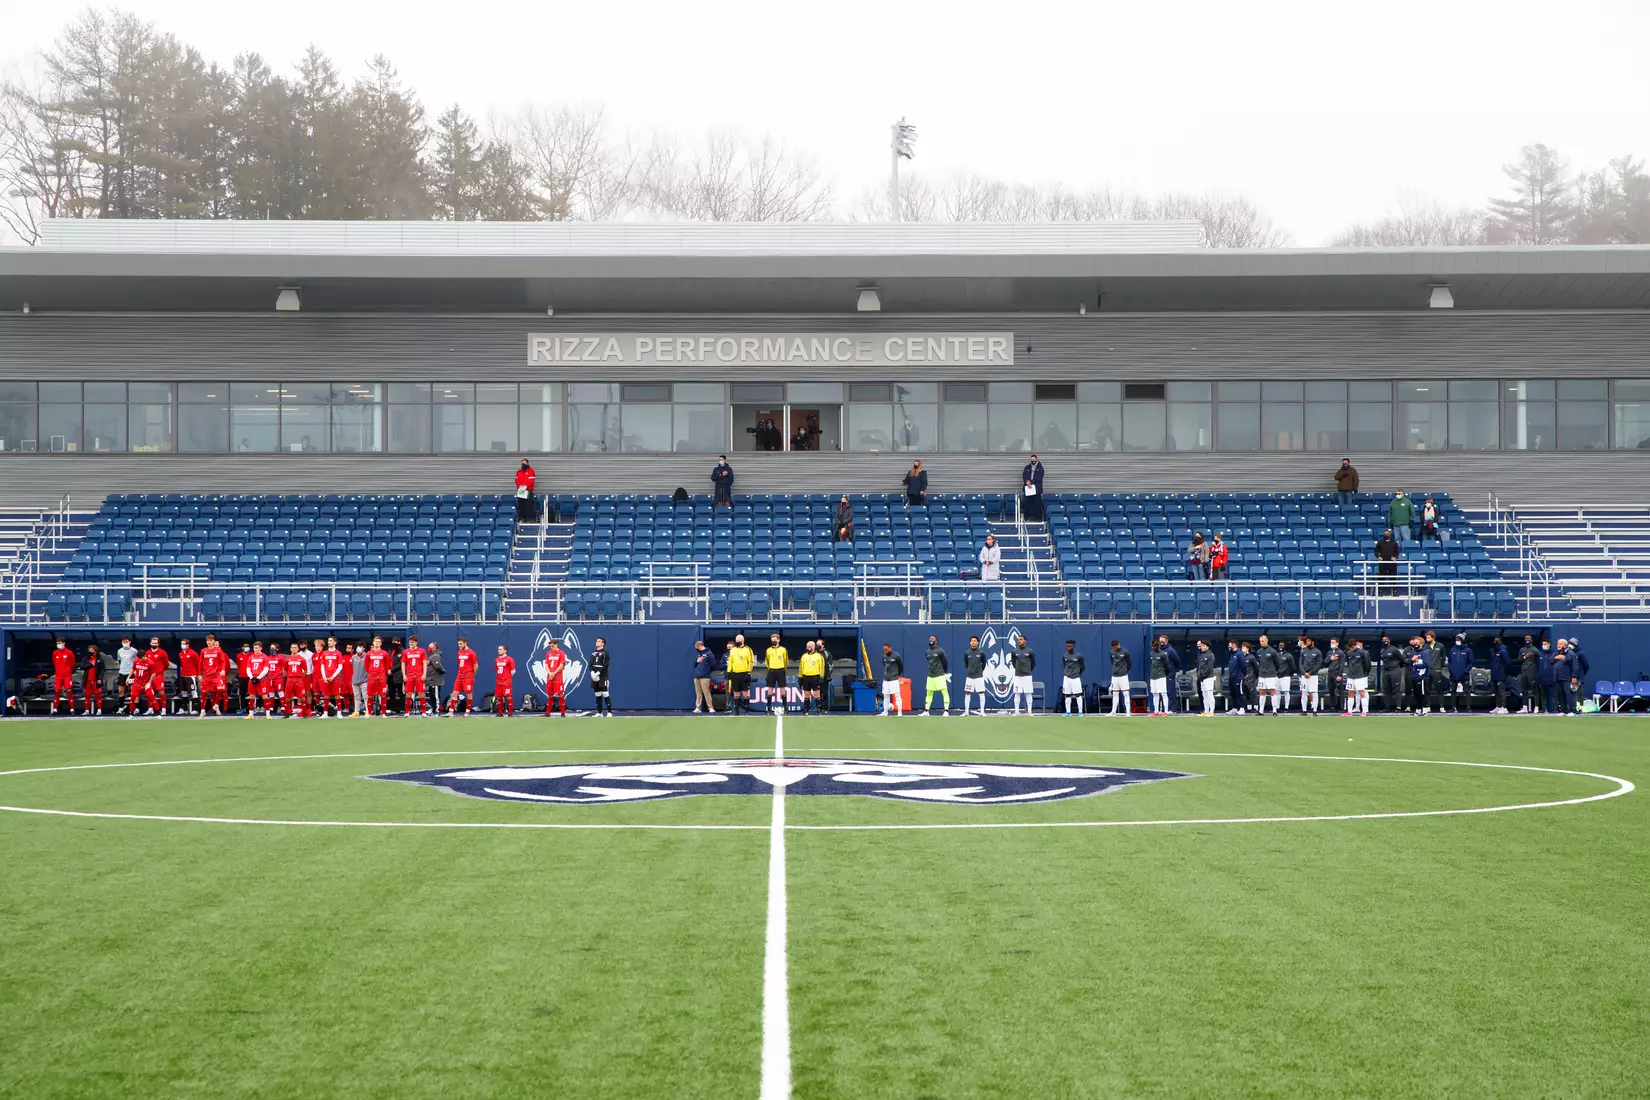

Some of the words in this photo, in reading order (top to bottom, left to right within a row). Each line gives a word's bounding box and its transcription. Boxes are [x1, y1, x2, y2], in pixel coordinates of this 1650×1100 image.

[532, 337, 624, 361] RIZZA
[635, 337, 873, 362] PERFORMANCE
[884, 336, 1009, 361] CENTER
[208, 658, 213, 666] 5
[328, 660, 332, 668] 7
[373, 660, 380, 668] 19
